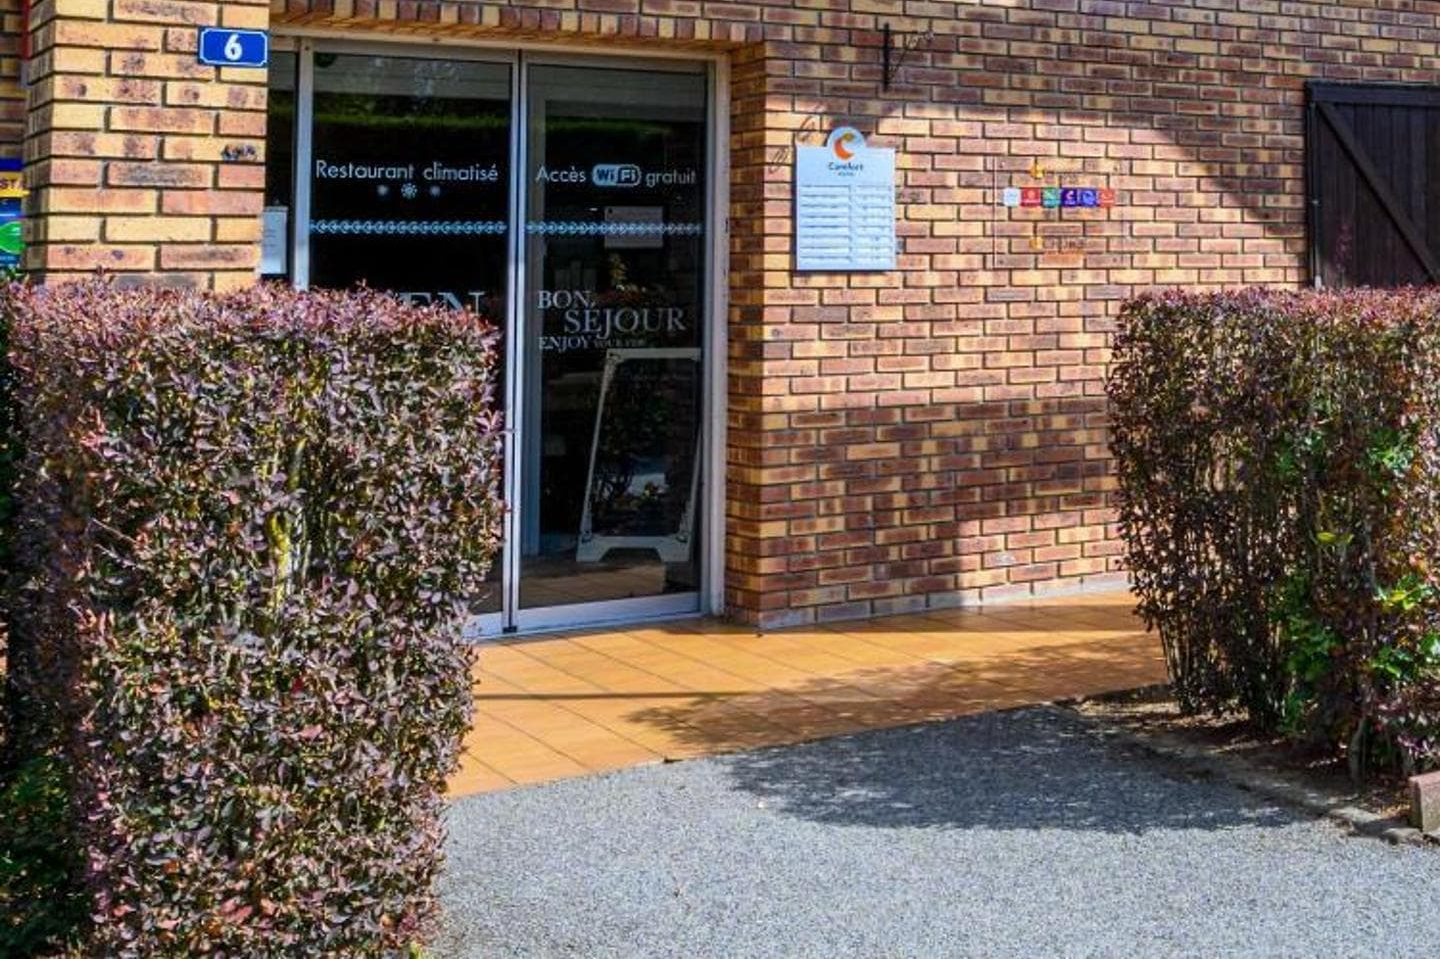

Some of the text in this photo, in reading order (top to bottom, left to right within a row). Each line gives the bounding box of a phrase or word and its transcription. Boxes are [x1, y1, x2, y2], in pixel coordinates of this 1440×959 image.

[224, 33, 243, 61] 6
[315, 159, 499, 182] Restaurant climatisé
[535, 166, 587, 184] Accès
[645, 169, 697, 188] gratuit
[538, 337, 592, 353] ENJOY
